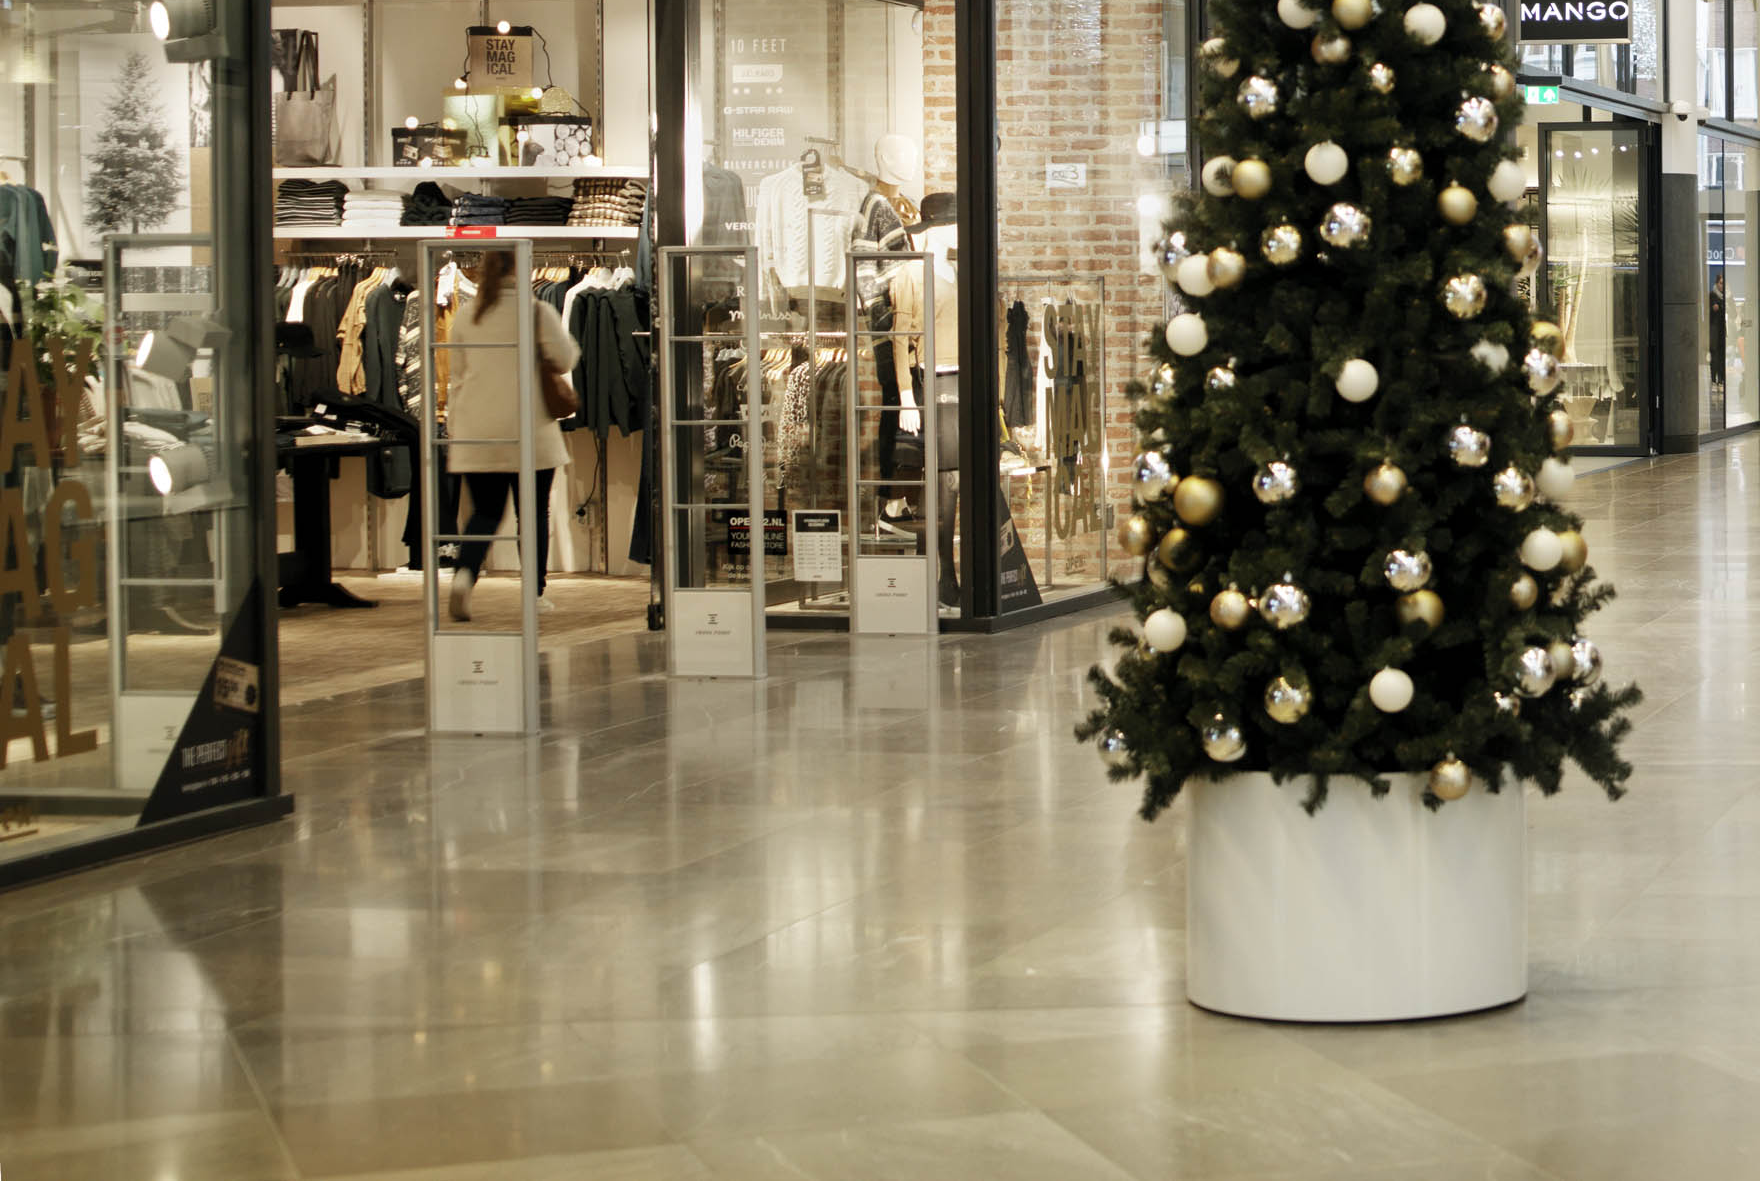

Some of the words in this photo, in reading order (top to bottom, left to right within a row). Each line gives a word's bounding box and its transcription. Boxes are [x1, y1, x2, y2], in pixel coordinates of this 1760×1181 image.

[1520, 1, 1629, 21] MANGO
[486, 39, 516, 51] STAY
[731, 38, 745, 53] 10
[752, 38, 787, 53] FEET
[486, 51, 516, 63] MAG
[486, 63, 516, 75] ICAL
[732, 128, 784, 139] HILFIGER
[1043, 303, 1101, 380] STAY
[1044, 381, 1101, 460] MAG
[729, 516, 785, 527] OPE2.NL
